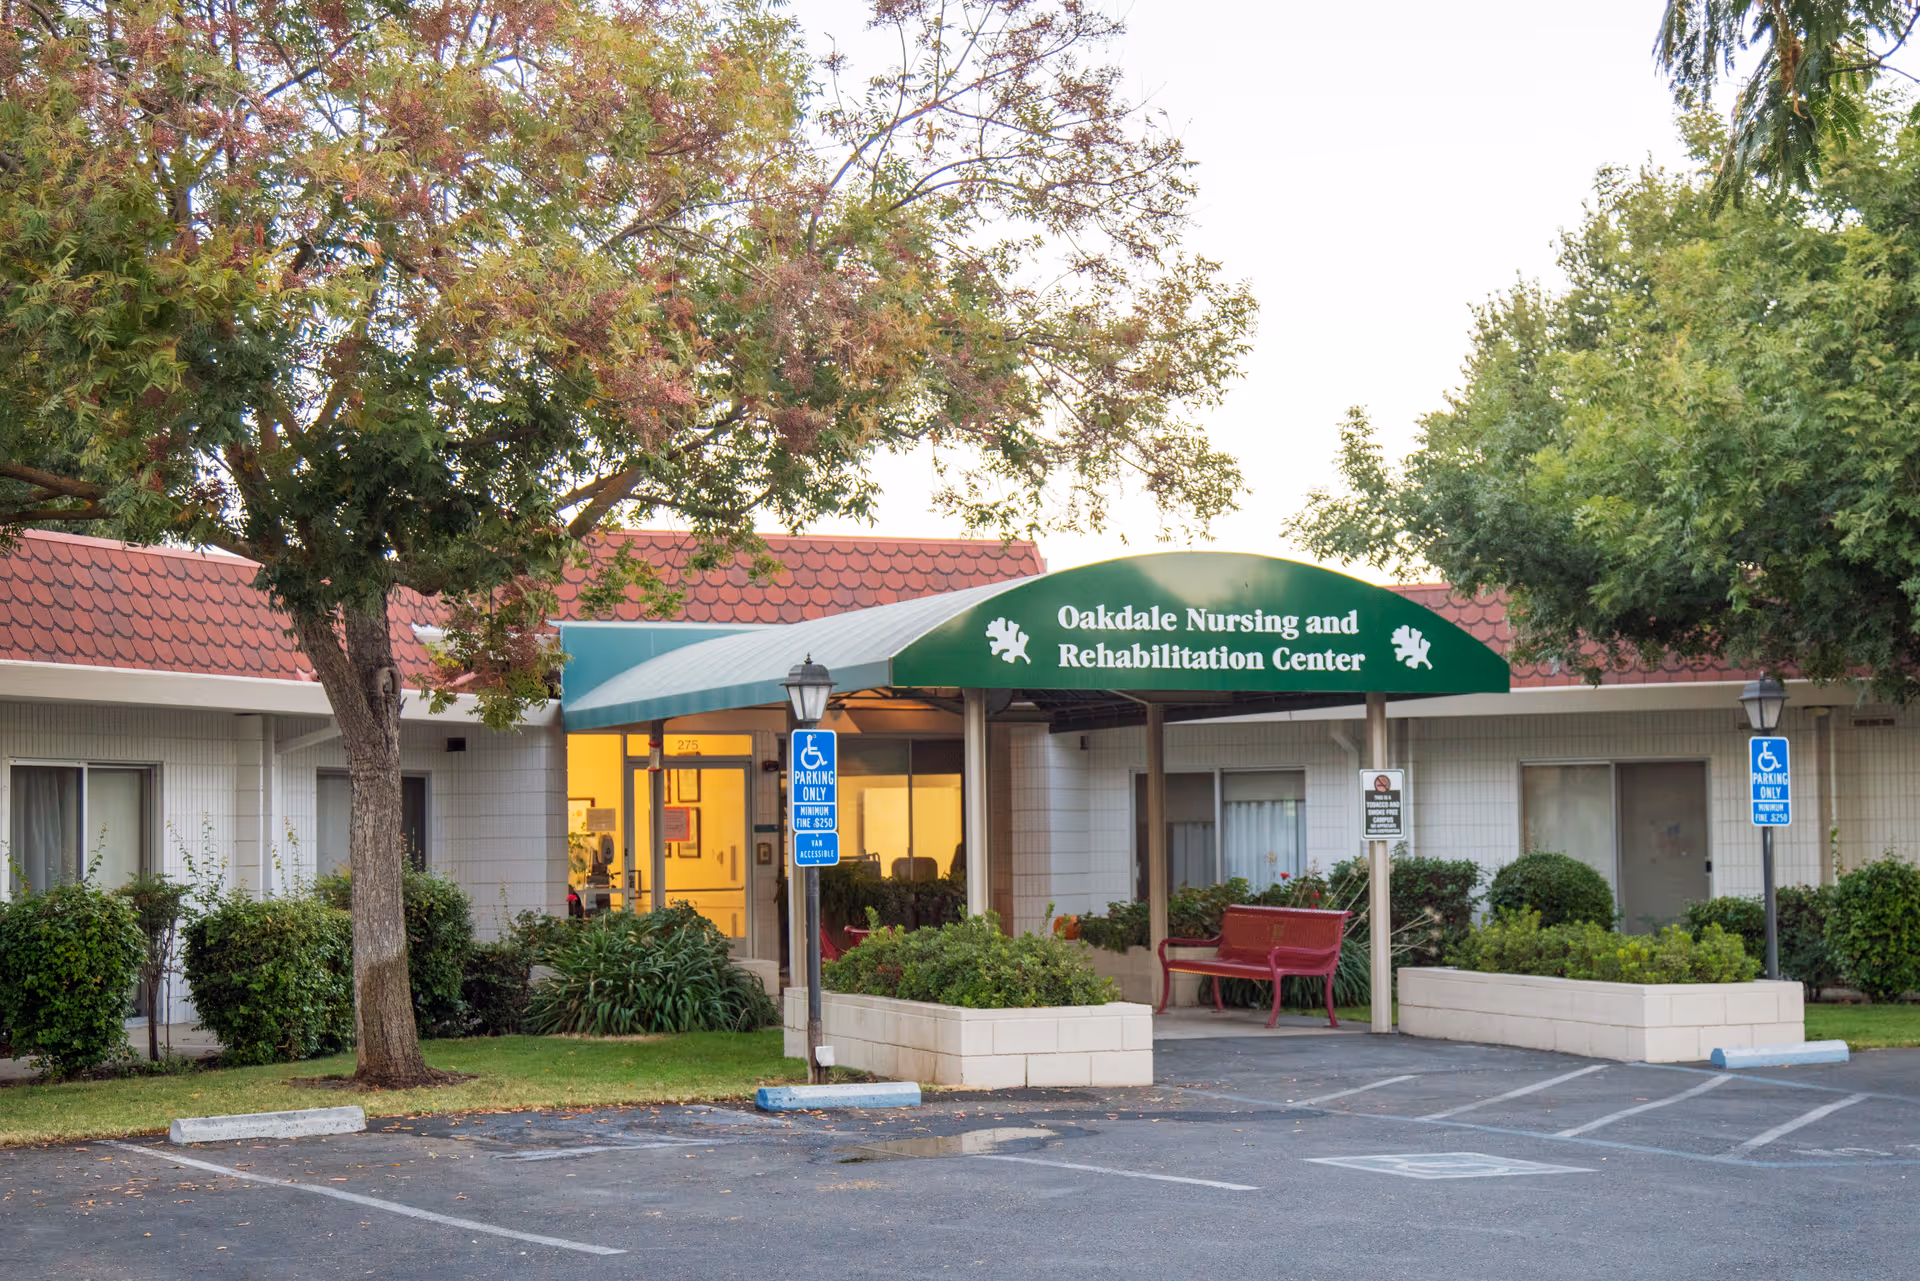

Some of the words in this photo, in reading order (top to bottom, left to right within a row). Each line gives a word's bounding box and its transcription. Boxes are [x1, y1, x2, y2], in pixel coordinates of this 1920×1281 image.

[1057, 604, 1177, 631] Oakdale
[1185, 608, 1299, 640] Nursing
[1305, 610, 1359, 635] and
[1058, 642, 1265, 670] Rehabilitation
[1272, 647, 1366, 671] Center
[677, 739, 699, 750] 275
[794, 770, 834, 785] PARKING
[1752, 772, 1788, 785] PARKING
[802, 786, 826, 801] ONLY
[1760, 786, 1781, 798] ONLY
[800, 806, 829, 815] MINIMUM
[796, 818, 810, 828] FINE
[814, 818, 833, 828] $250
[1755, 814, 1768, 822] FINE
[800, 850, 834, 858] ACCESSIBLE
